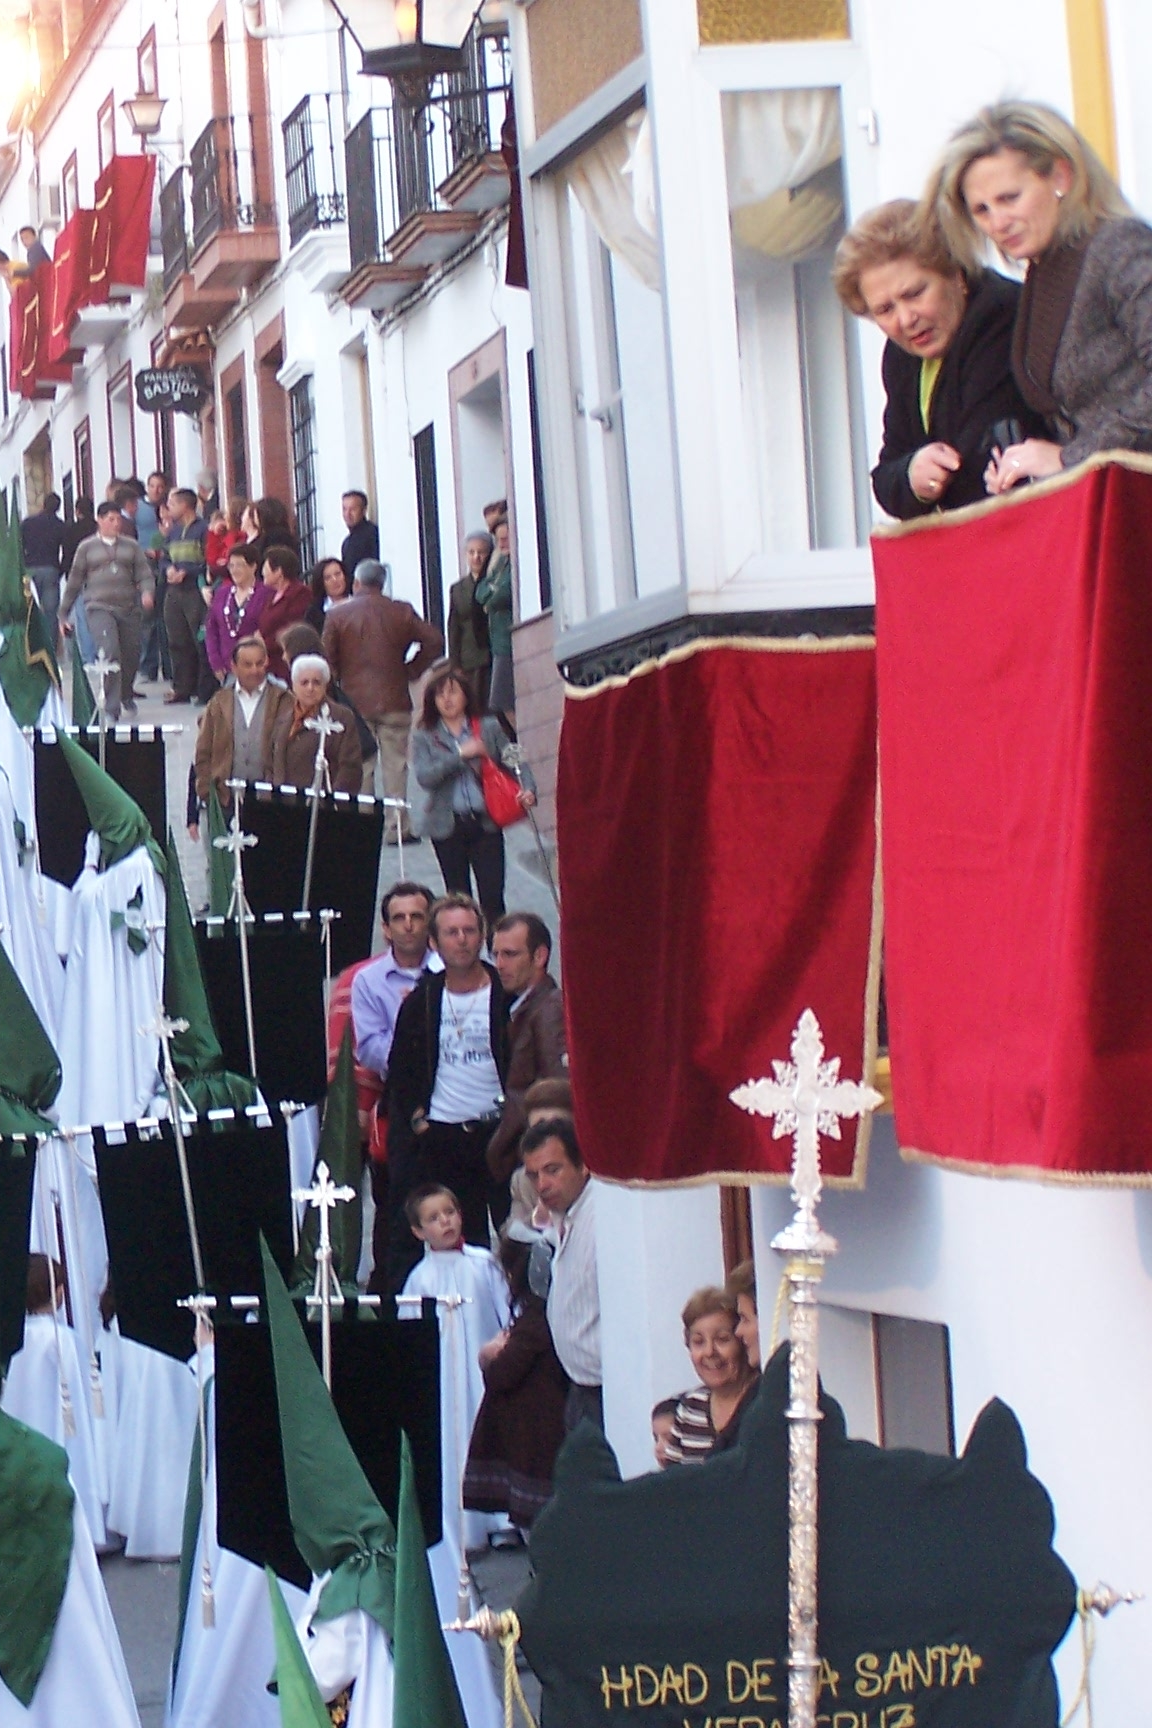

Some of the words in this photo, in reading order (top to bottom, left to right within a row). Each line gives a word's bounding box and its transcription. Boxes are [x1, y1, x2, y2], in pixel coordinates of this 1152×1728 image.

[601, 1662, 709, 1709] HDAD
[726, 1658, 778, 1703] DE
[854, 1642, 983, 1698] SANTA
